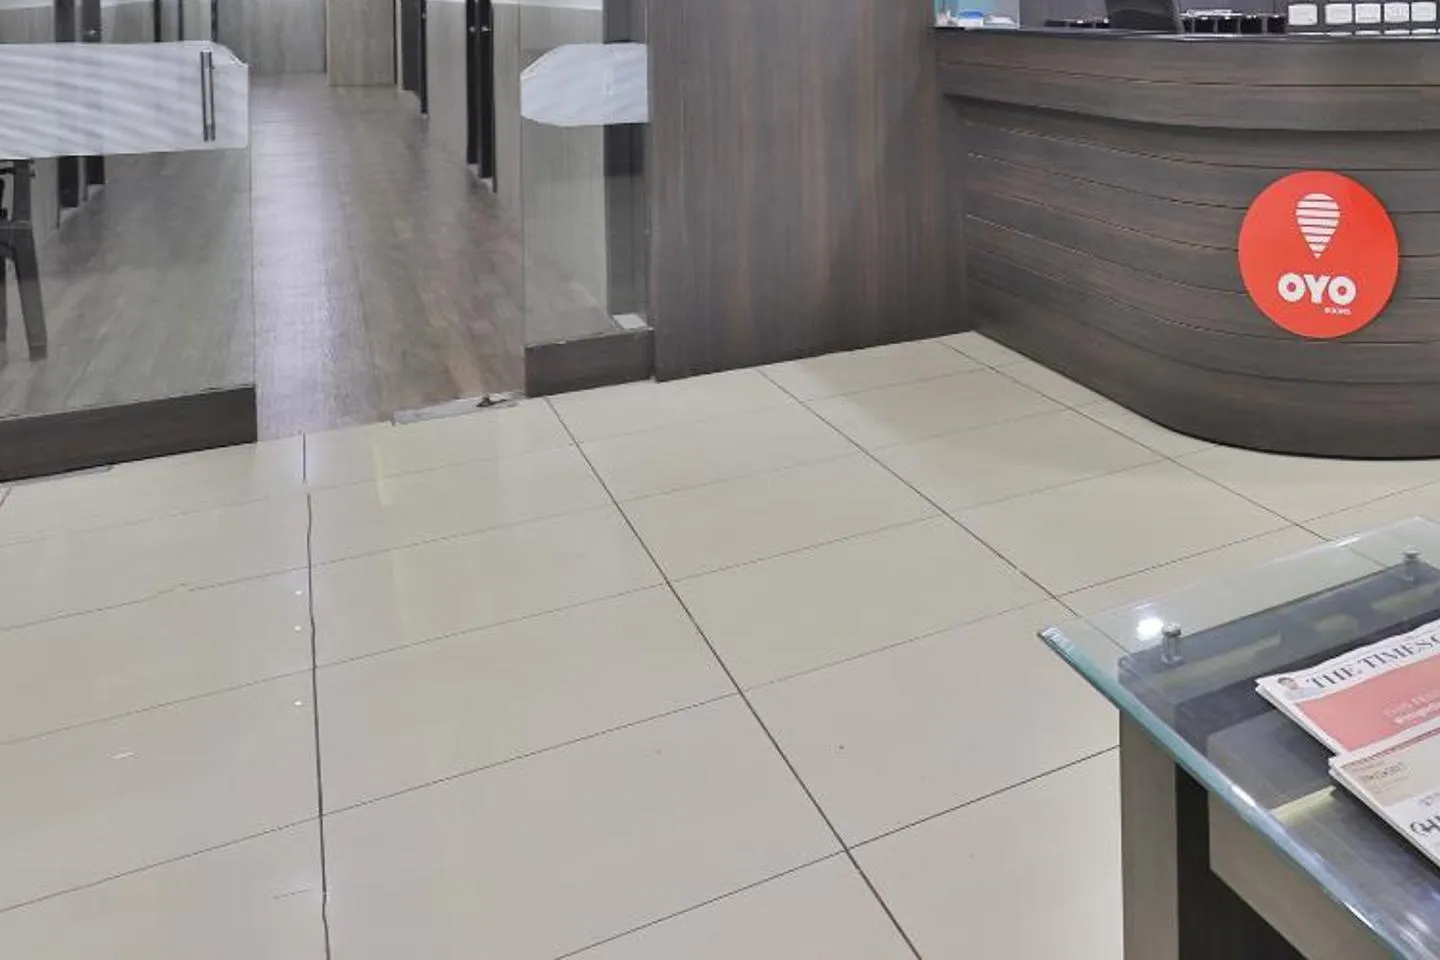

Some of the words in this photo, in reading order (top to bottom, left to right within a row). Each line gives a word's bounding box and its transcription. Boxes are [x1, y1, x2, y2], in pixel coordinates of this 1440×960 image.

[1278, 272, 1357, 305] OYO
[1304, 664, 1360, 690] THE
[1361, 641, 1432, 671] TIMES
